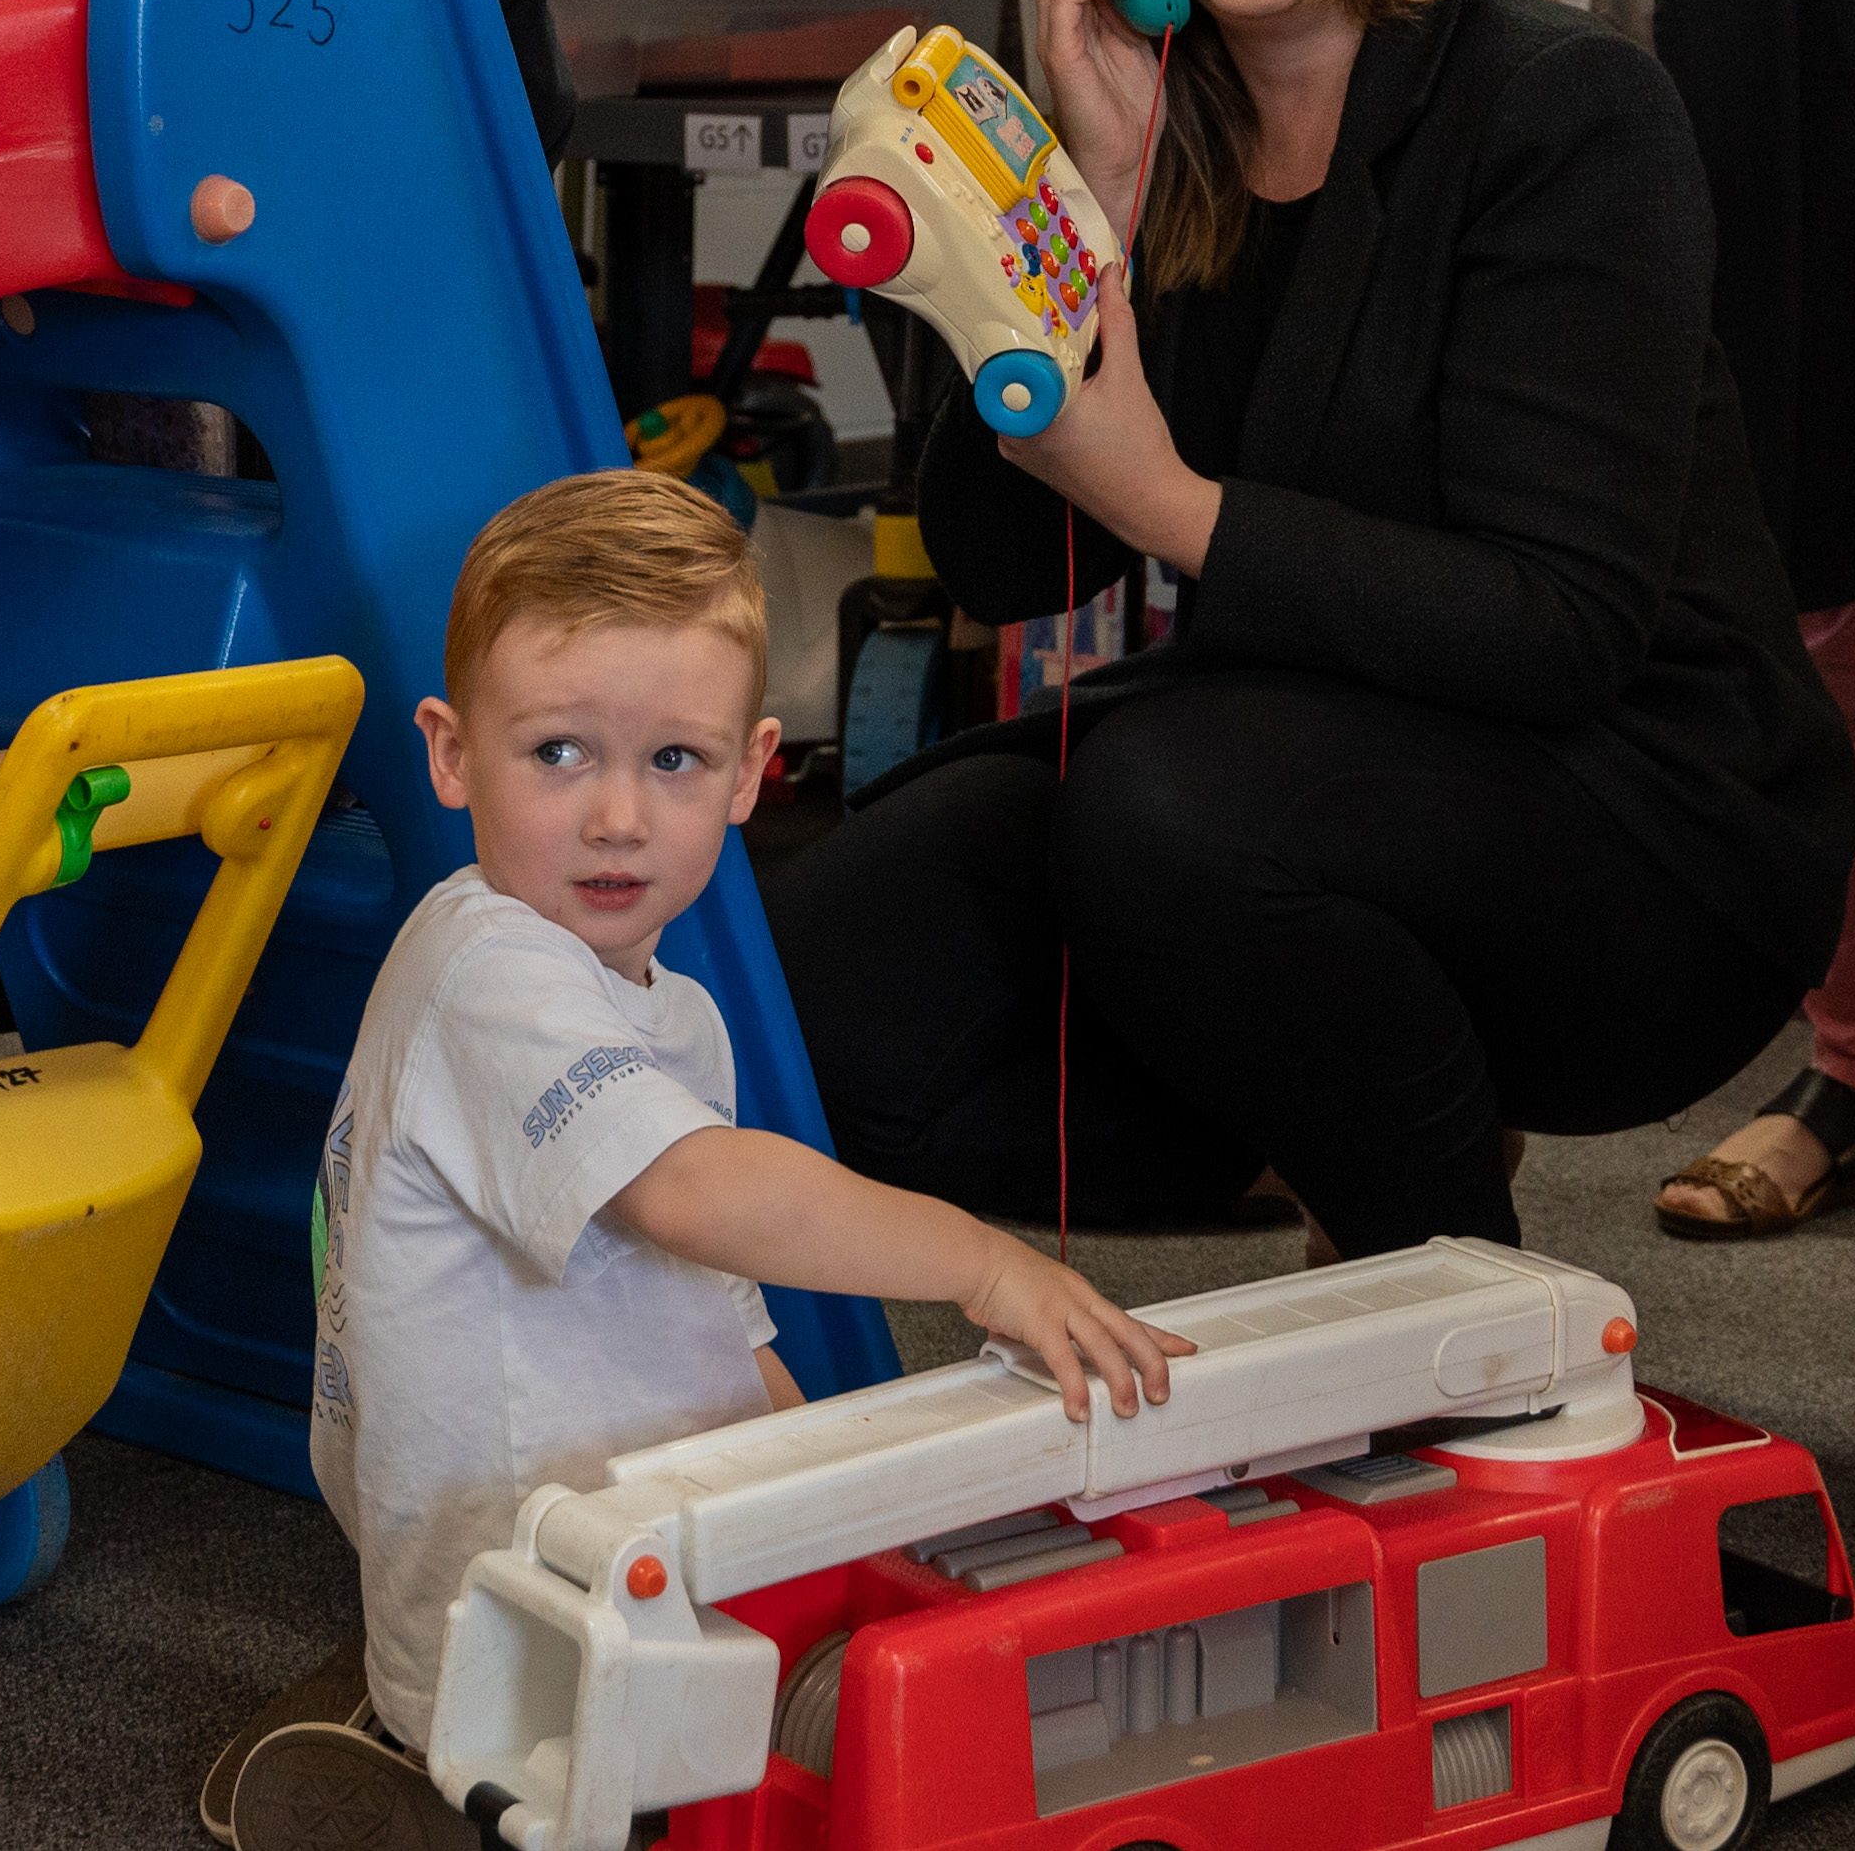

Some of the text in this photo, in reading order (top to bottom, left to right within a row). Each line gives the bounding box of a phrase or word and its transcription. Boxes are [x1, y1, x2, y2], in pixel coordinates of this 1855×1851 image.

[522, 1078, 575, 1149] SUN
[549, 1102, 583, 1143] SURFS
[587, 1084, 604, 1099] UP
